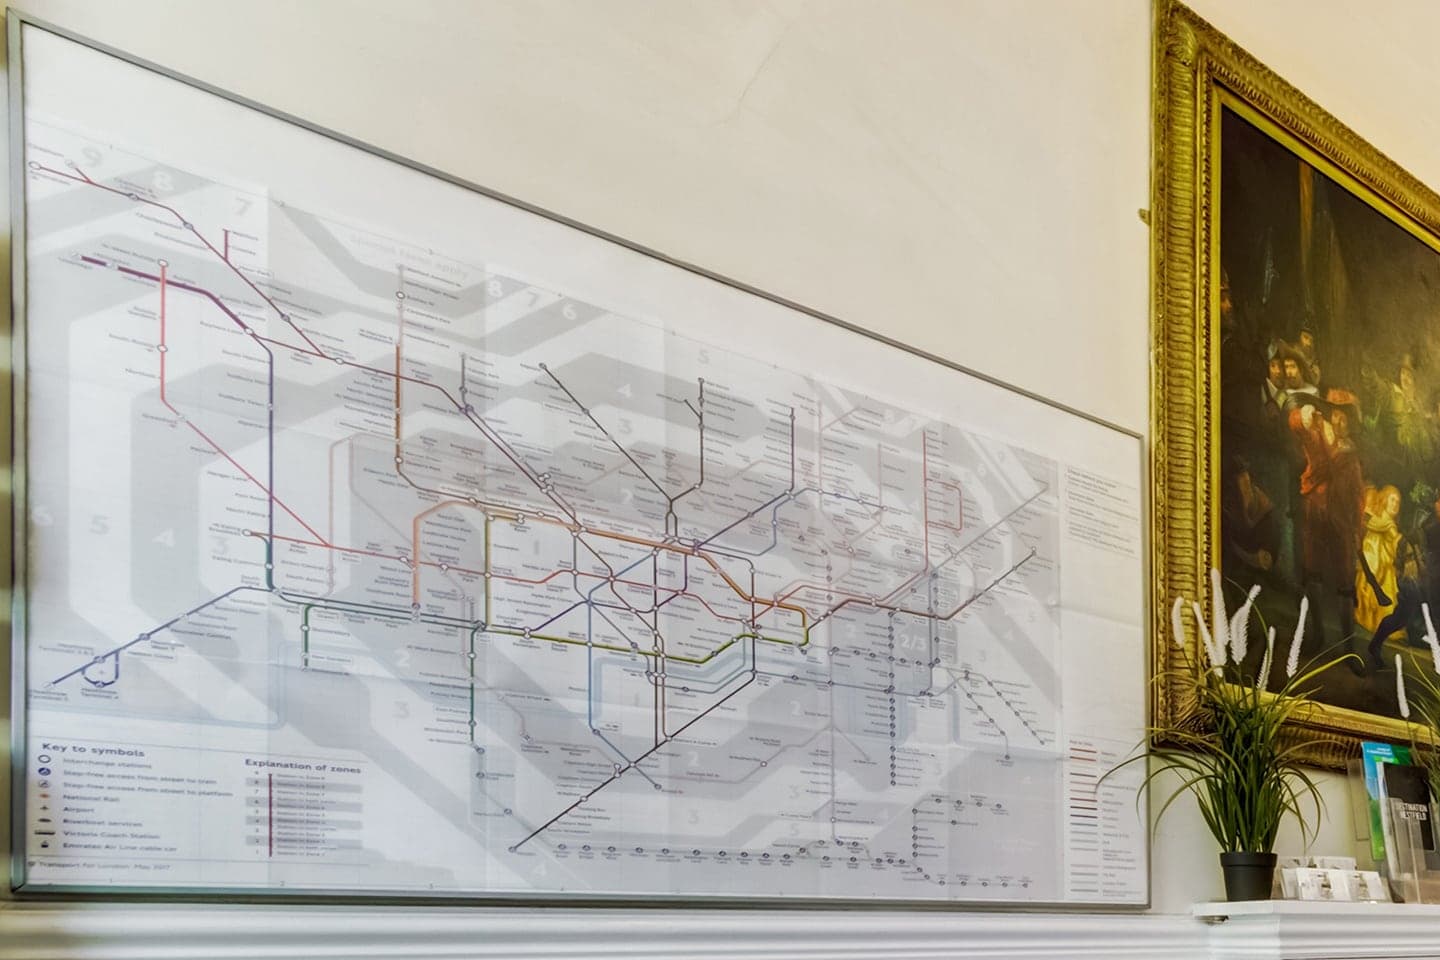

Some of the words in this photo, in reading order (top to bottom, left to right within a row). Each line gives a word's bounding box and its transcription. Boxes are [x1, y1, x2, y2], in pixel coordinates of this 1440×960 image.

[901, 633, 927, 649] 2/3
[42, 743, 67, 753] Key
[72, 745, 86, 753] to
[91, 746, 145, 758] symbols
[245, 759, 312, 770] Explanation
